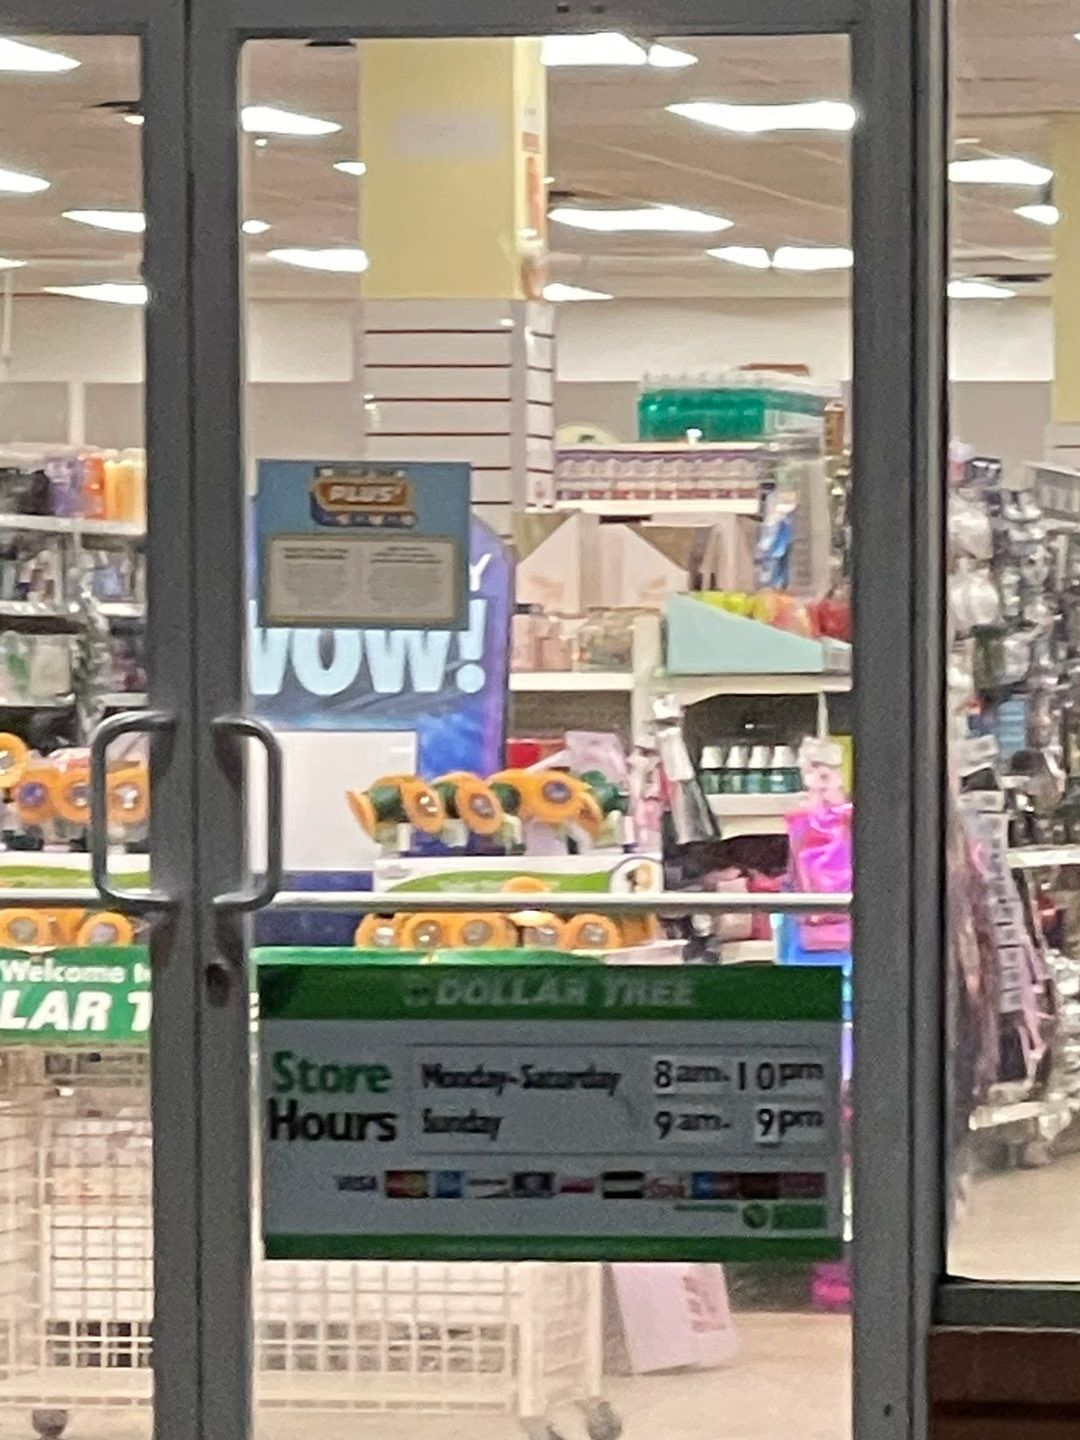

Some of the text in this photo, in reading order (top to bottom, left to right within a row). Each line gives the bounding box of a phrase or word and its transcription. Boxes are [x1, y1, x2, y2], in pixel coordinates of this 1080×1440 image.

[434, 973, 591, 1008] DOLLAR
[271, 1050, 393, 1094] Store
[267, 1098, 399, 1142] Hours
[422, 1107, 504, 1142] Sunday
